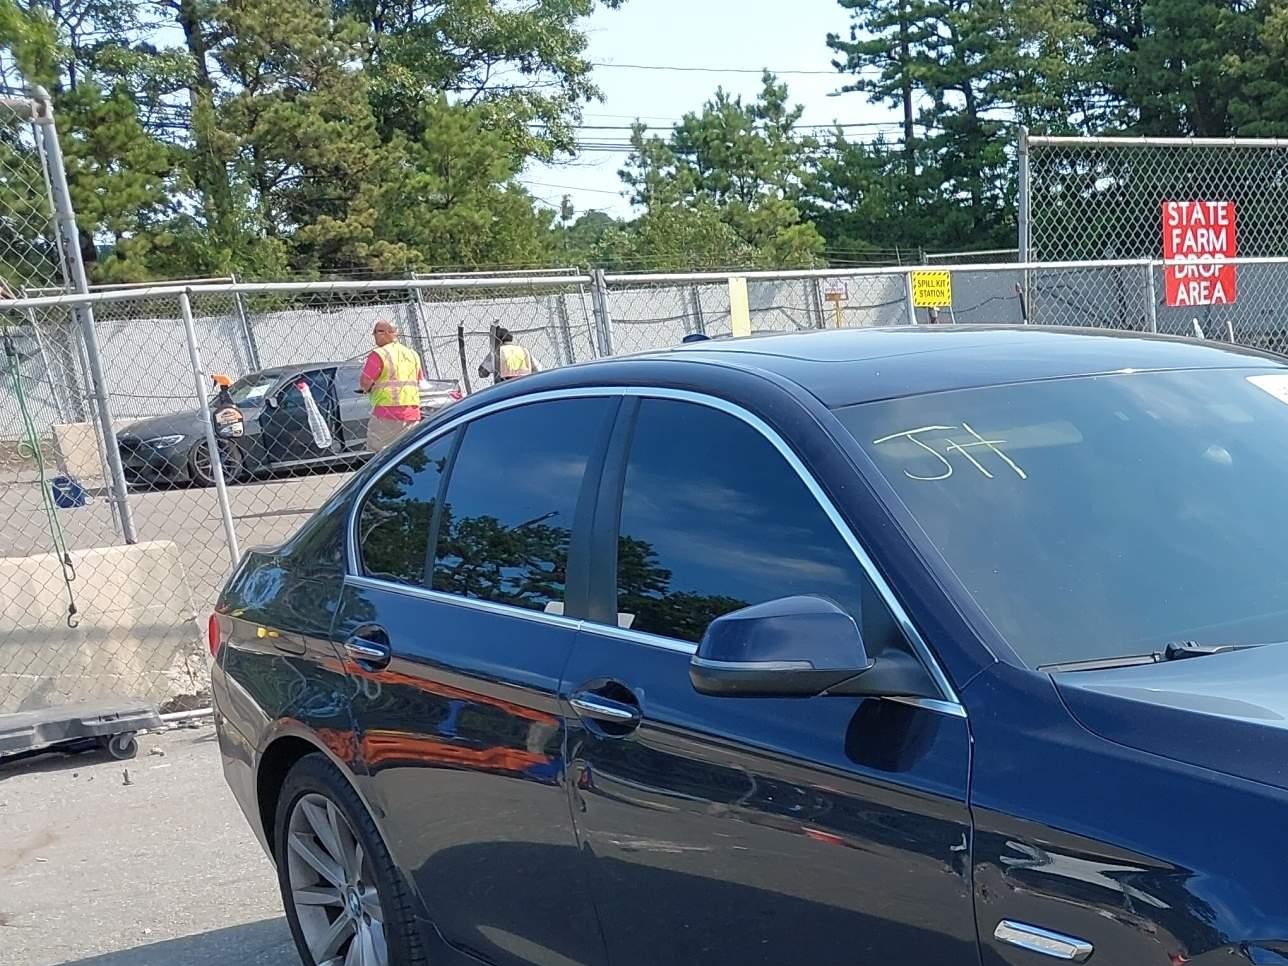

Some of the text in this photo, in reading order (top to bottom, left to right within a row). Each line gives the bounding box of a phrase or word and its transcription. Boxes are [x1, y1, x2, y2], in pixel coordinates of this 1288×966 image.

[1168, 201, 1229, 226] STATE
[1172, 227, 1227, 253] FARM
[1174, 254, 1226, 279] DROP
[917, 279, 946, 288] SPILL KIT
[919, 289, 945, 298] STATION
[1176, 280, 1227, 306] AREA
